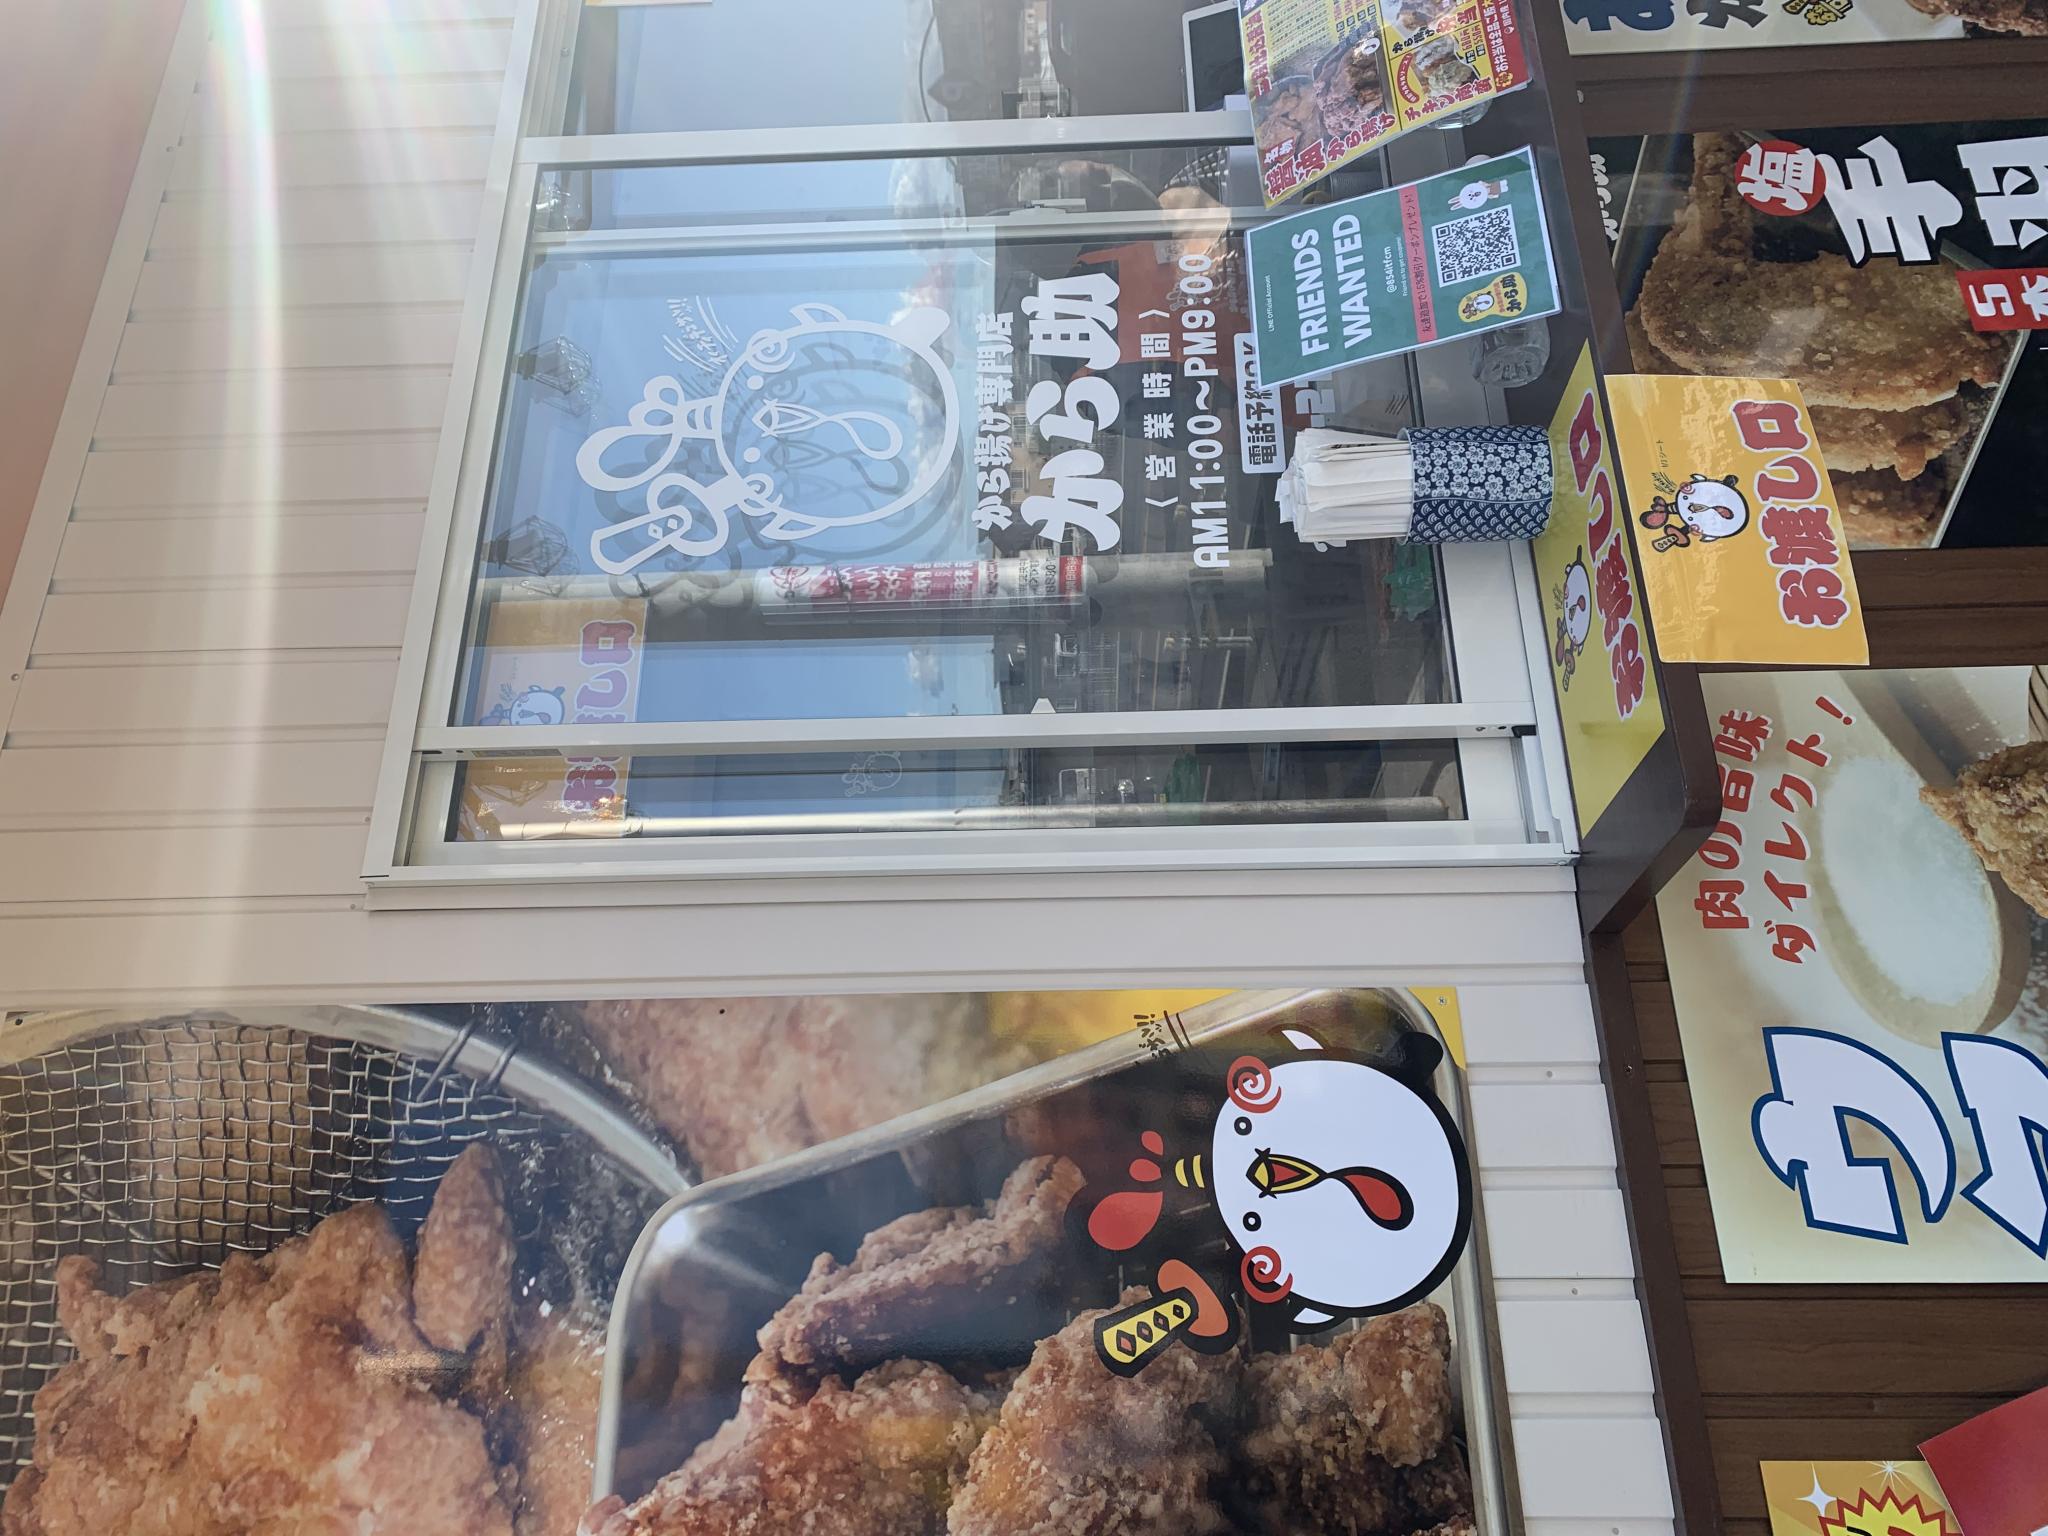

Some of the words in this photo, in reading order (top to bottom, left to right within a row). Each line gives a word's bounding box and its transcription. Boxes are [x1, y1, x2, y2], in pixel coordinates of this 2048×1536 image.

[1265, 111, 1396, 199] 醤油から揚げ
[1404, 76, 1493, 122] チキン南蛮
[1735, 141, 1815, 211] 塩
[1267, 318, 1275, 332] LINE
[1290, 228, 1330, 356] FRIENDS
[1333, 214, 1373, 349] WANTED
[1505, 274, 1522, 313] から助
[971, 311, 1014, 530] から揚げ専門店
[1020, 272, 1124, 552] から助
[1568, 390, 1647, 718] お渡し口
[1732, 398, 1848, 628] お渡し口
[561, 620, 635, 811] おし口
[1763, 695, 1854, 964] ダイレクト!
